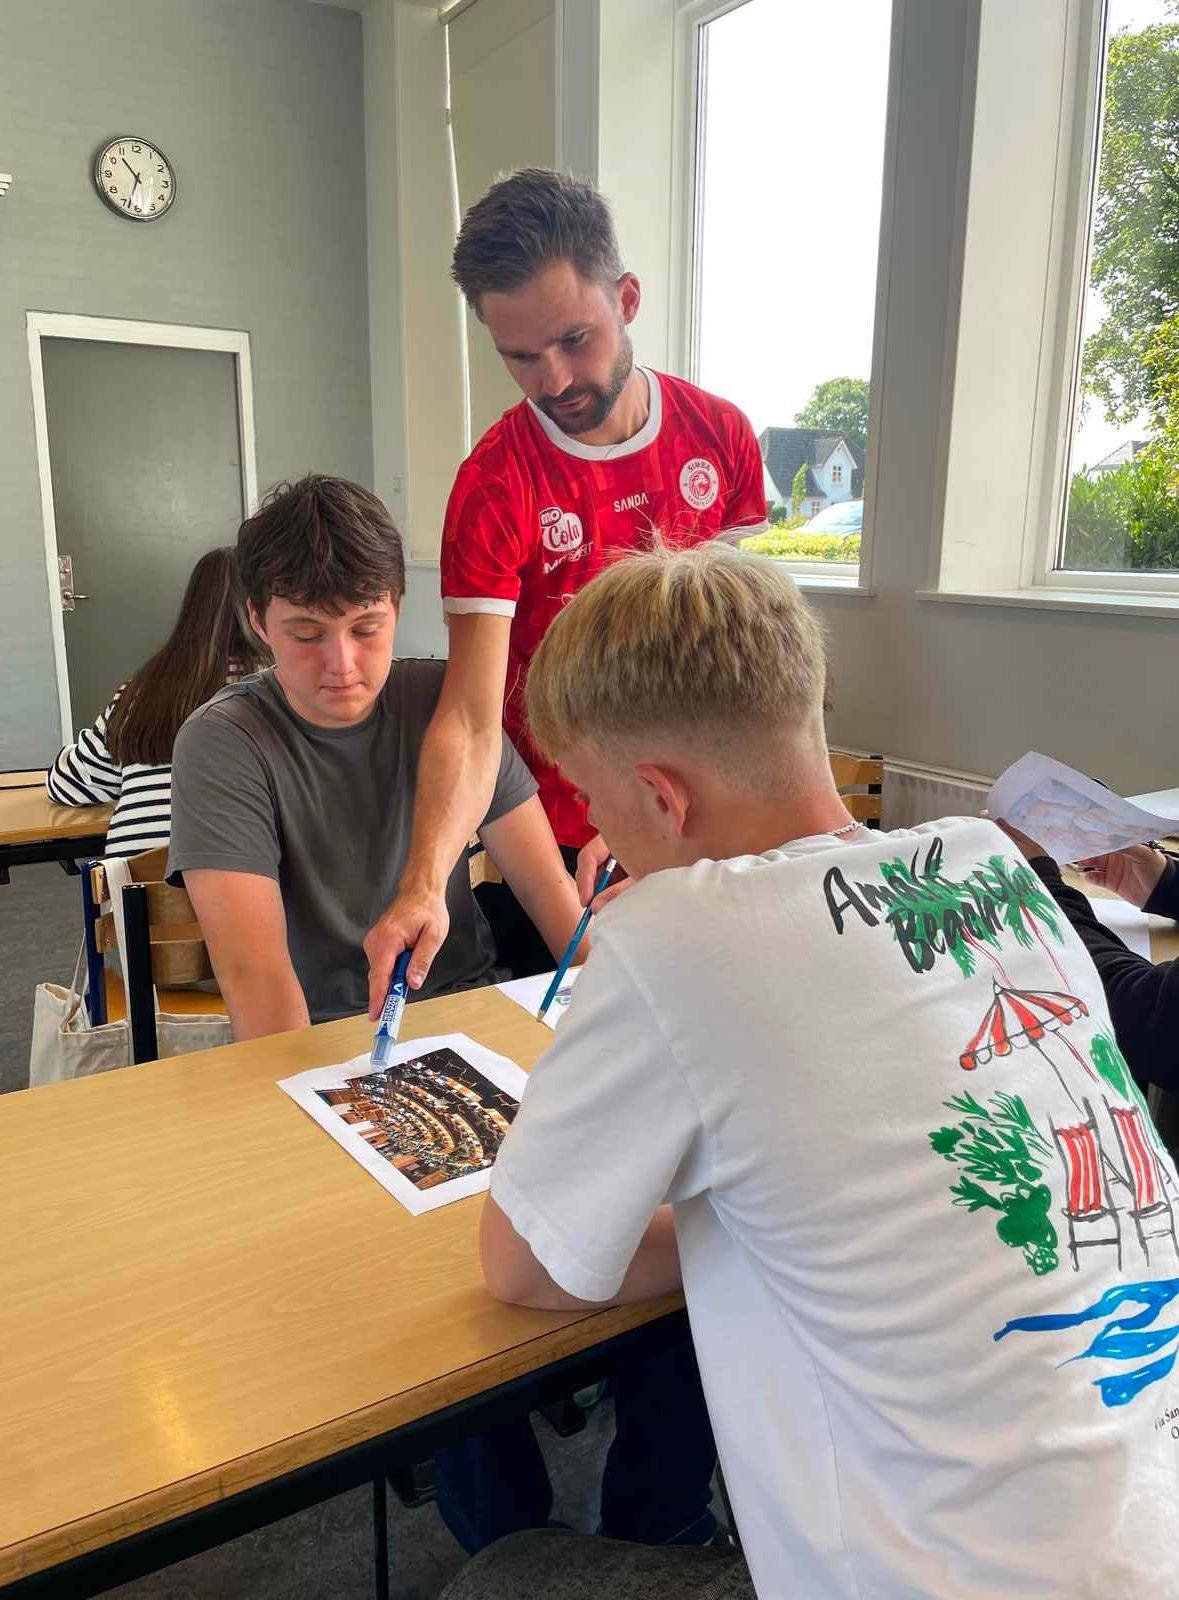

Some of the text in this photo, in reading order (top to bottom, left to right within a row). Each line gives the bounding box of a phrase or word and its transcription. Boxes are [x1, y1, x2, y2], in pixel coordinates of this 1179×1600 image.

[131, 144, 142, 154] 12
[156, 164, 165, 173] 2
[104, 169, 113, 178] 9
[161, 180, 169, 189] 3
[109, 185, 118, 194] 8
[120, 198, 128, 207] 7
[158, 194, 165, 202] 4
[133, 204, 143, 213] 6
[613, 492, 650, 513] SANDA
